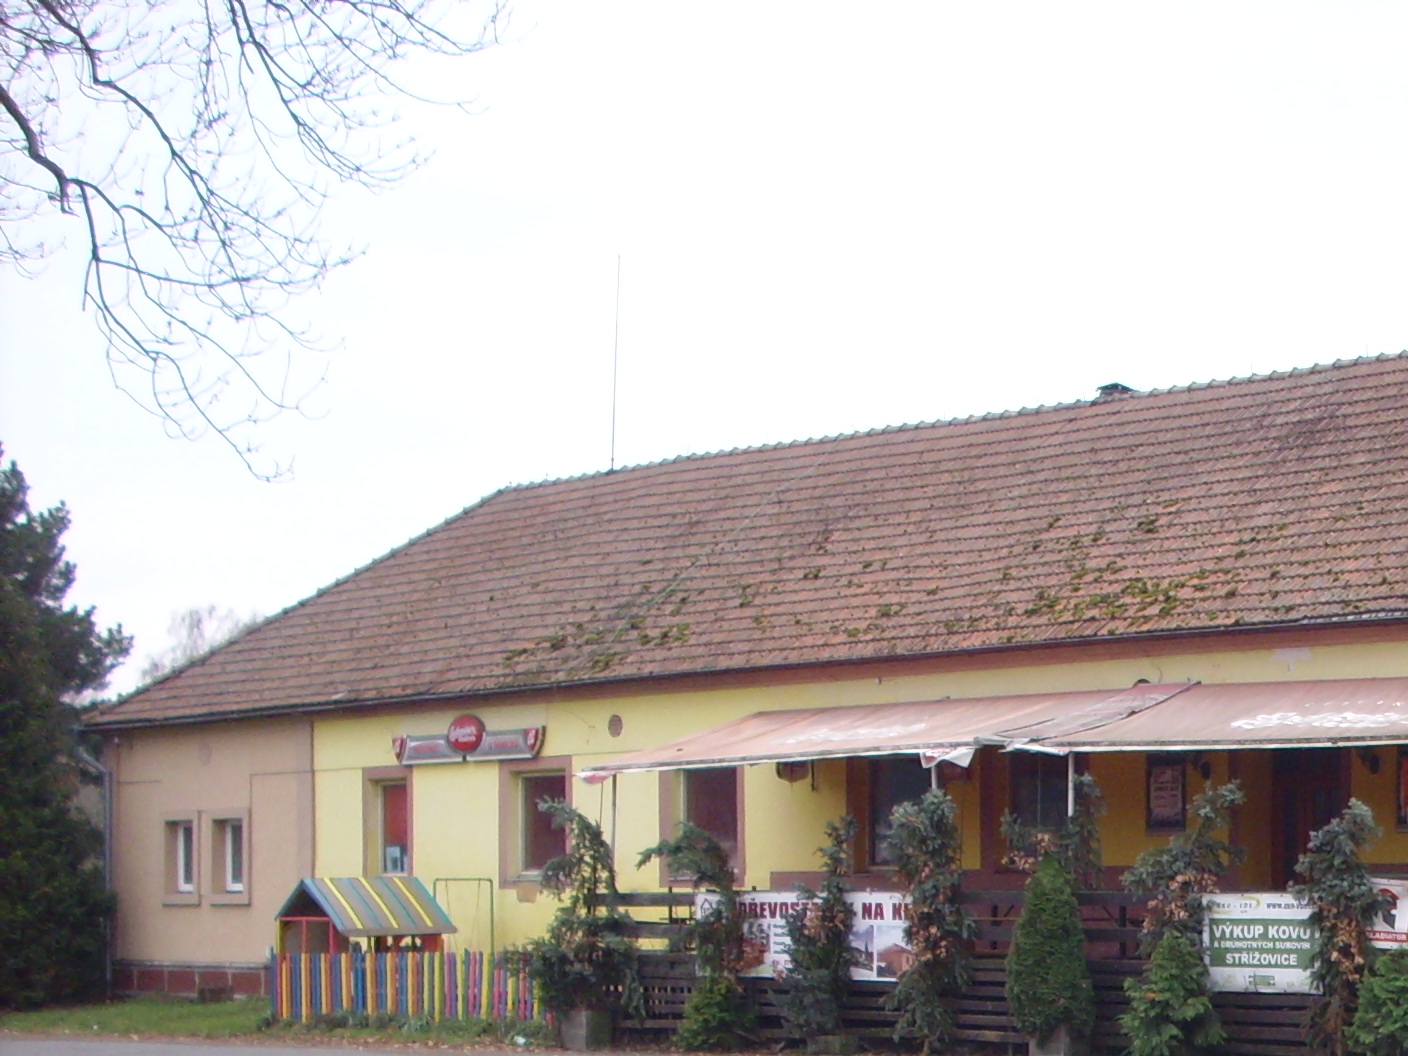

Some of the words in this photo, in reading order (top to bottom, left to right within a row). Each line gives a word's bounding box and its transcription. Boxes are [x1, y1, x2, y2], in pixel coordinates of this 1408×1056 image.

[861, 902, 885, 920] NA
[1212, 922, 1264, 939] VÝKUP
[1225, 951, 1298, 966] STŘÍŽOVICE
